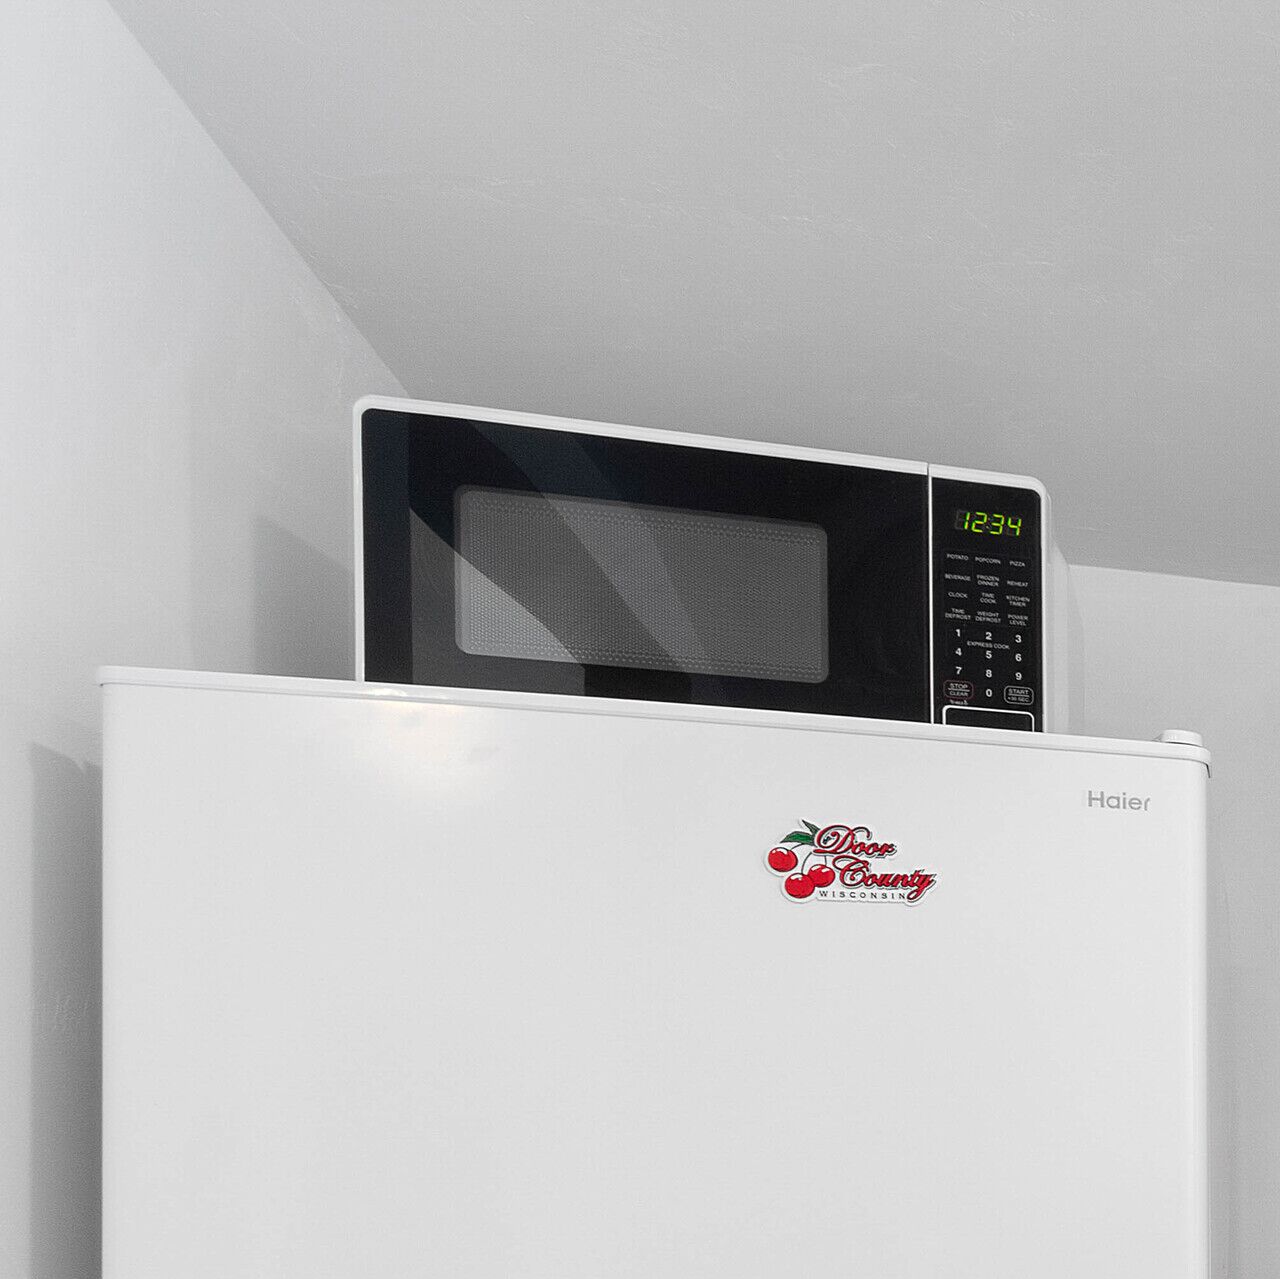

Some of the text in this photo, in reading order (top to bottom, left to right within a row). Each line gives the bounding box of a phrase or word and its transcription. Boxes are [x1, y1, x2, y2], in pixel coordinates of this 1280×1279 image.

[946, 553, 969, 561] POTATO
[975, 556, 1001, 564] POPCORN
[1006, 580, 1029, 588] REHEAT
[955, 628, 961, 637] 1
[985, 631, 992, 640] 2
[1014, 634, 1022, 643] 3
[955, 647, 962, 656] 4
[985, 650, 992, 659] 5
[1015, 653, 1022, 662] 6
[955, 666, 962, 675] 7
[985, 669, 992, 678] 8
[1015, 672, 1022, 681] 9
[985, 688, 993, 697] 0
[1088, 790, 1151, 811] Haier
[813, 824, 897, 856] Door
[832, 854, 937, 902] County
[818, 890, 907, 900] WISCONSIN
